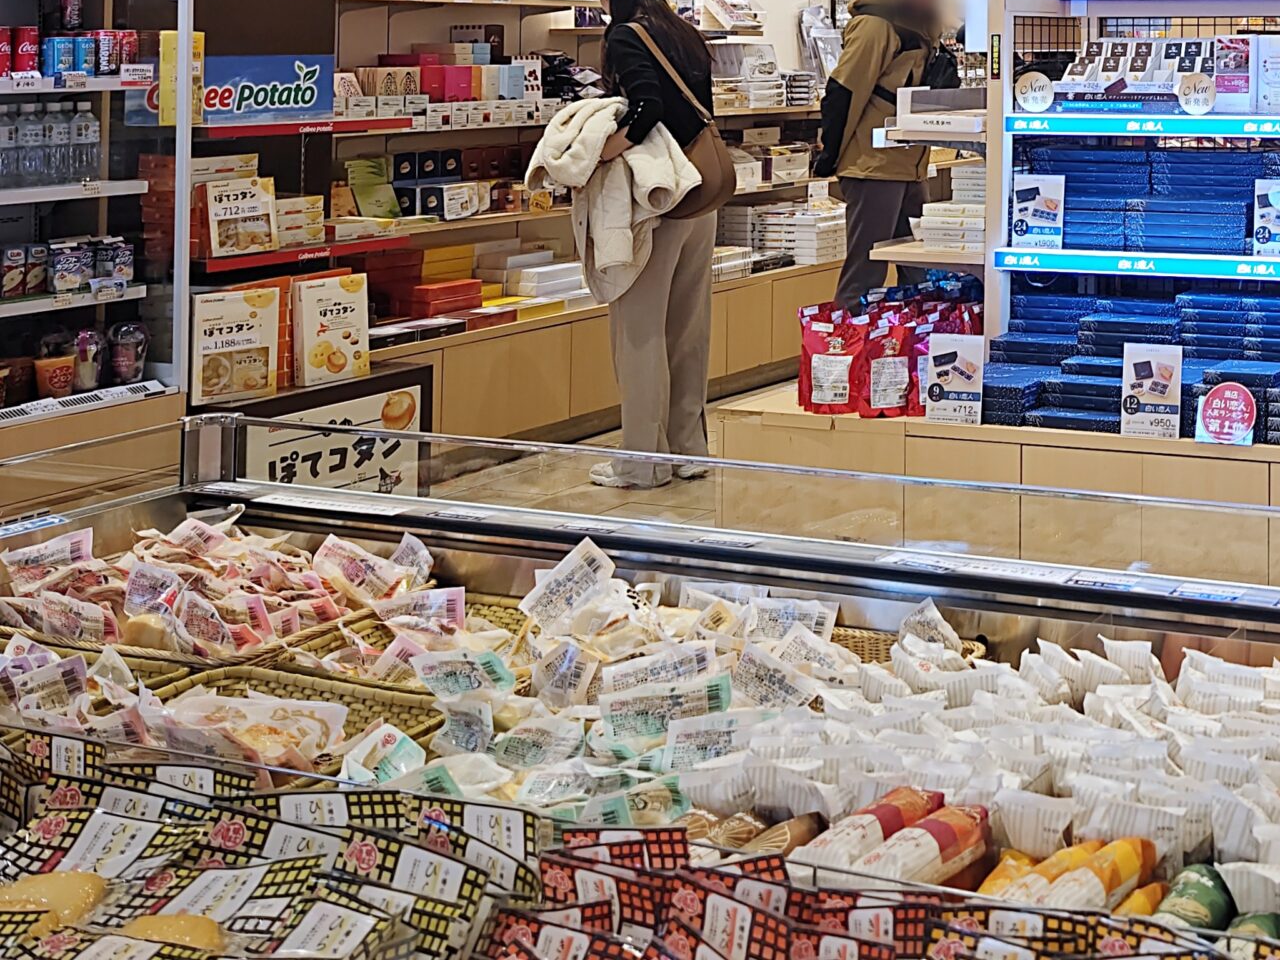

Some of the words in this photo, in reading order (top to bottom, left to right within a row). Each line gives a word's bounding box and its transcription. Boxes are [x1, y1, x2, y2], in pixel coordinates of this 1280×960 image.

[1019, 76, 1048, 95] New
[1183, 78, 1210, 96] New
[1015, 221, 1027, 231] 24
[1257, 228, 1269, 238] 24
[933, 385, 940, 396] 9
[1126, 397, 1138, 408] 12
